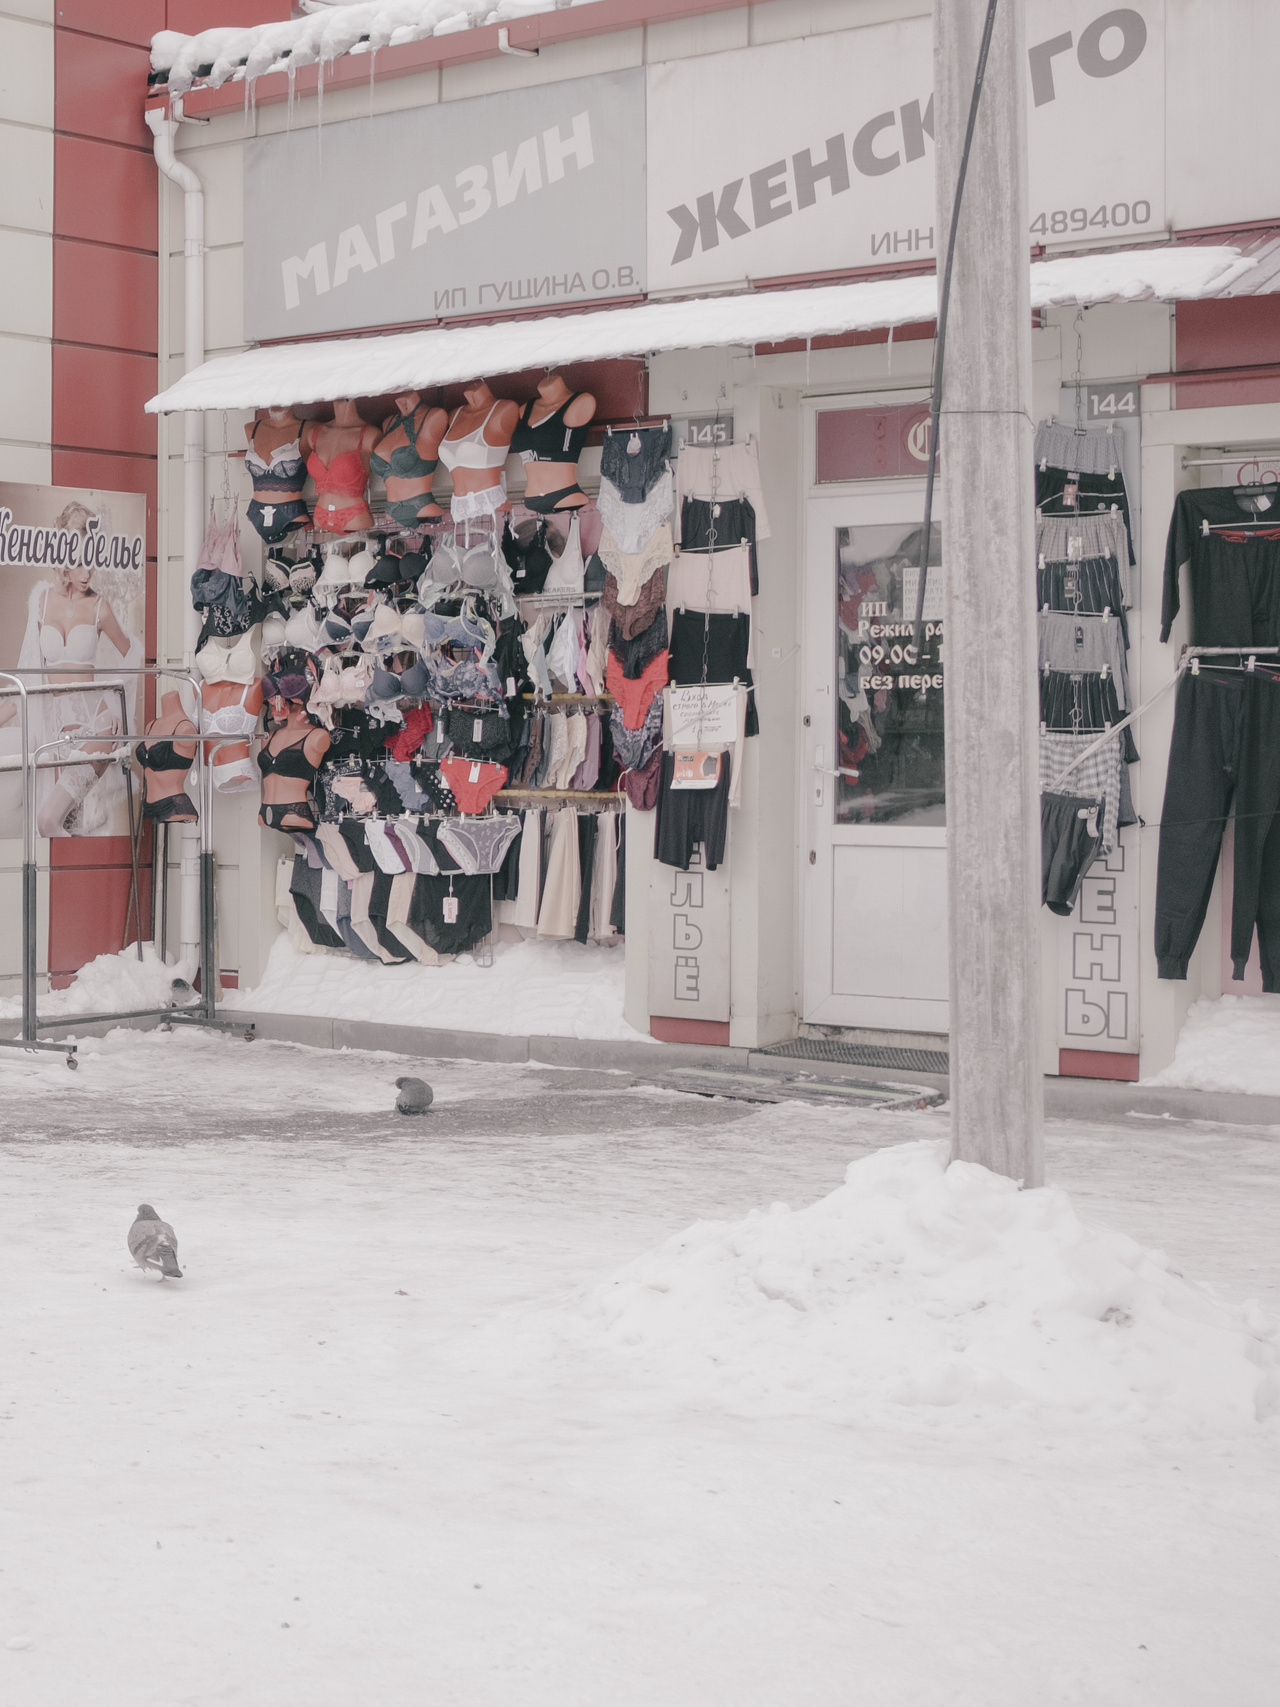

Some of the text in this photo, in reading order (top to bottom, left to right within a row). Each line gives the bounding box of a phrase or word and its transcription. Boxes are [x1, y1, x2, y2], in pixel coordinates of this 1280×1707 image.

[666, 8, 1148, 266] ЖЕНСКГО
[280, 110, 595, 312] МАГАЗИН
[870, 226, 934, 256] ИНН
[433, 265, 641, 311] ИП ГУЩИНА О.В.
[1090, 391, 1136, 416] 144
[690, 423, 727, 443] 145
[83, 518, 143, 571] белье
[861, 601, 888, 617] ИП
[898, 673, 944, 695] пере
[1064, 829, 1128, 1040] ЕНЫ
